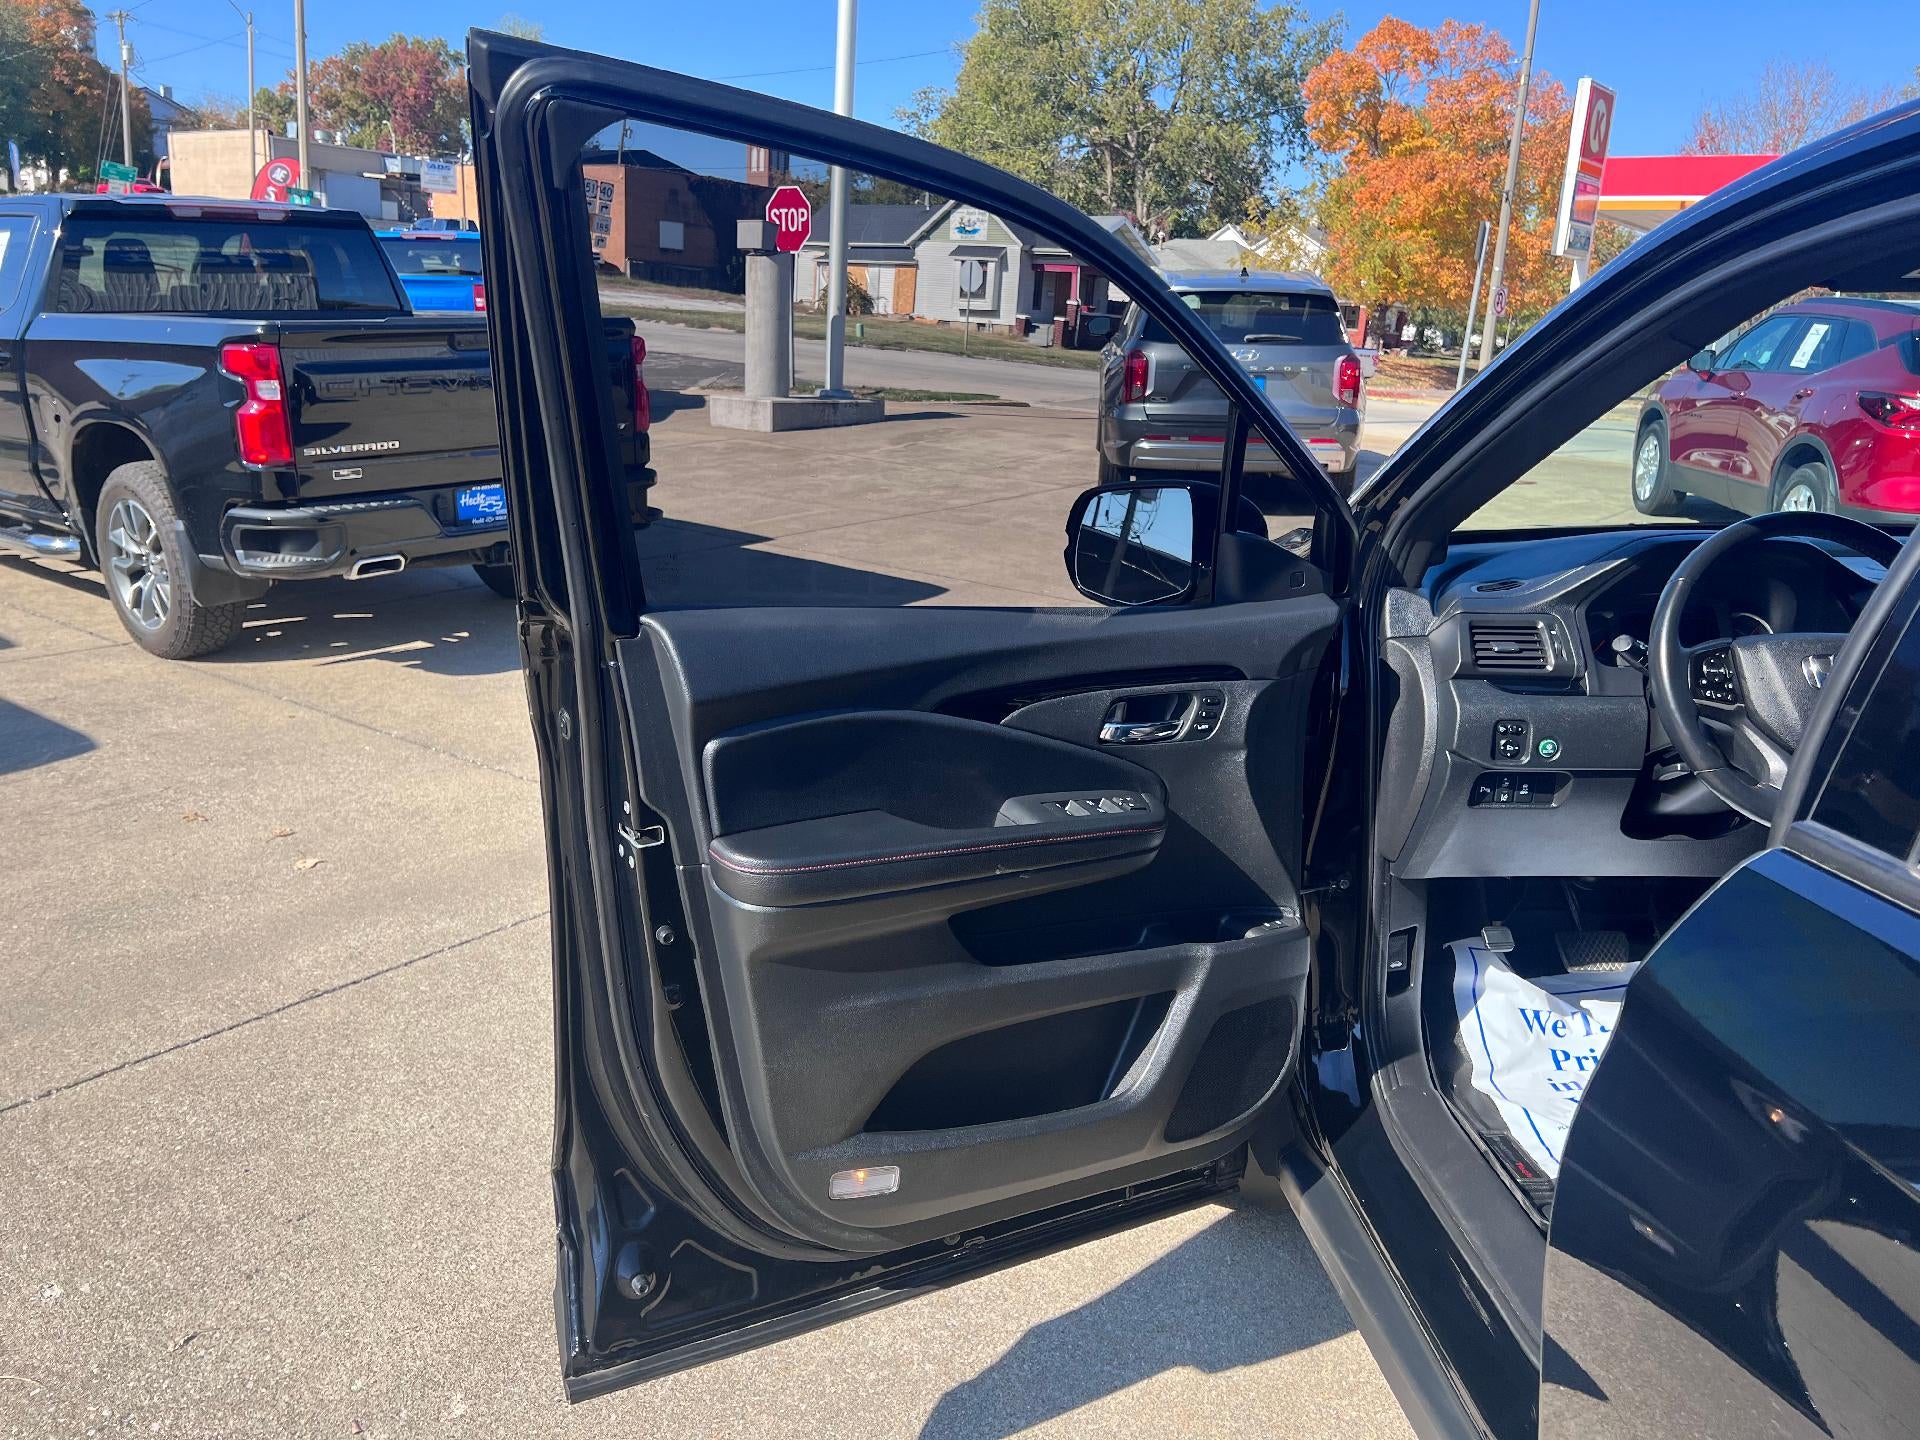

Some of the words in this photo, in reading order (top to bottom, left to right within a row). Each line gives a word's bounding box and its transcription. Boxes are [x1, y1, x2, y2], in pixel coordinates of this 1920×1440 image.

[601, 186, 612, 198] 40
[770, 208, 808, 232] STOP
[303, 440, 400, 456] SILVERADO
[460, 492, 486, 507] Hecht
[1518, 1008, 1567, 1038] We
